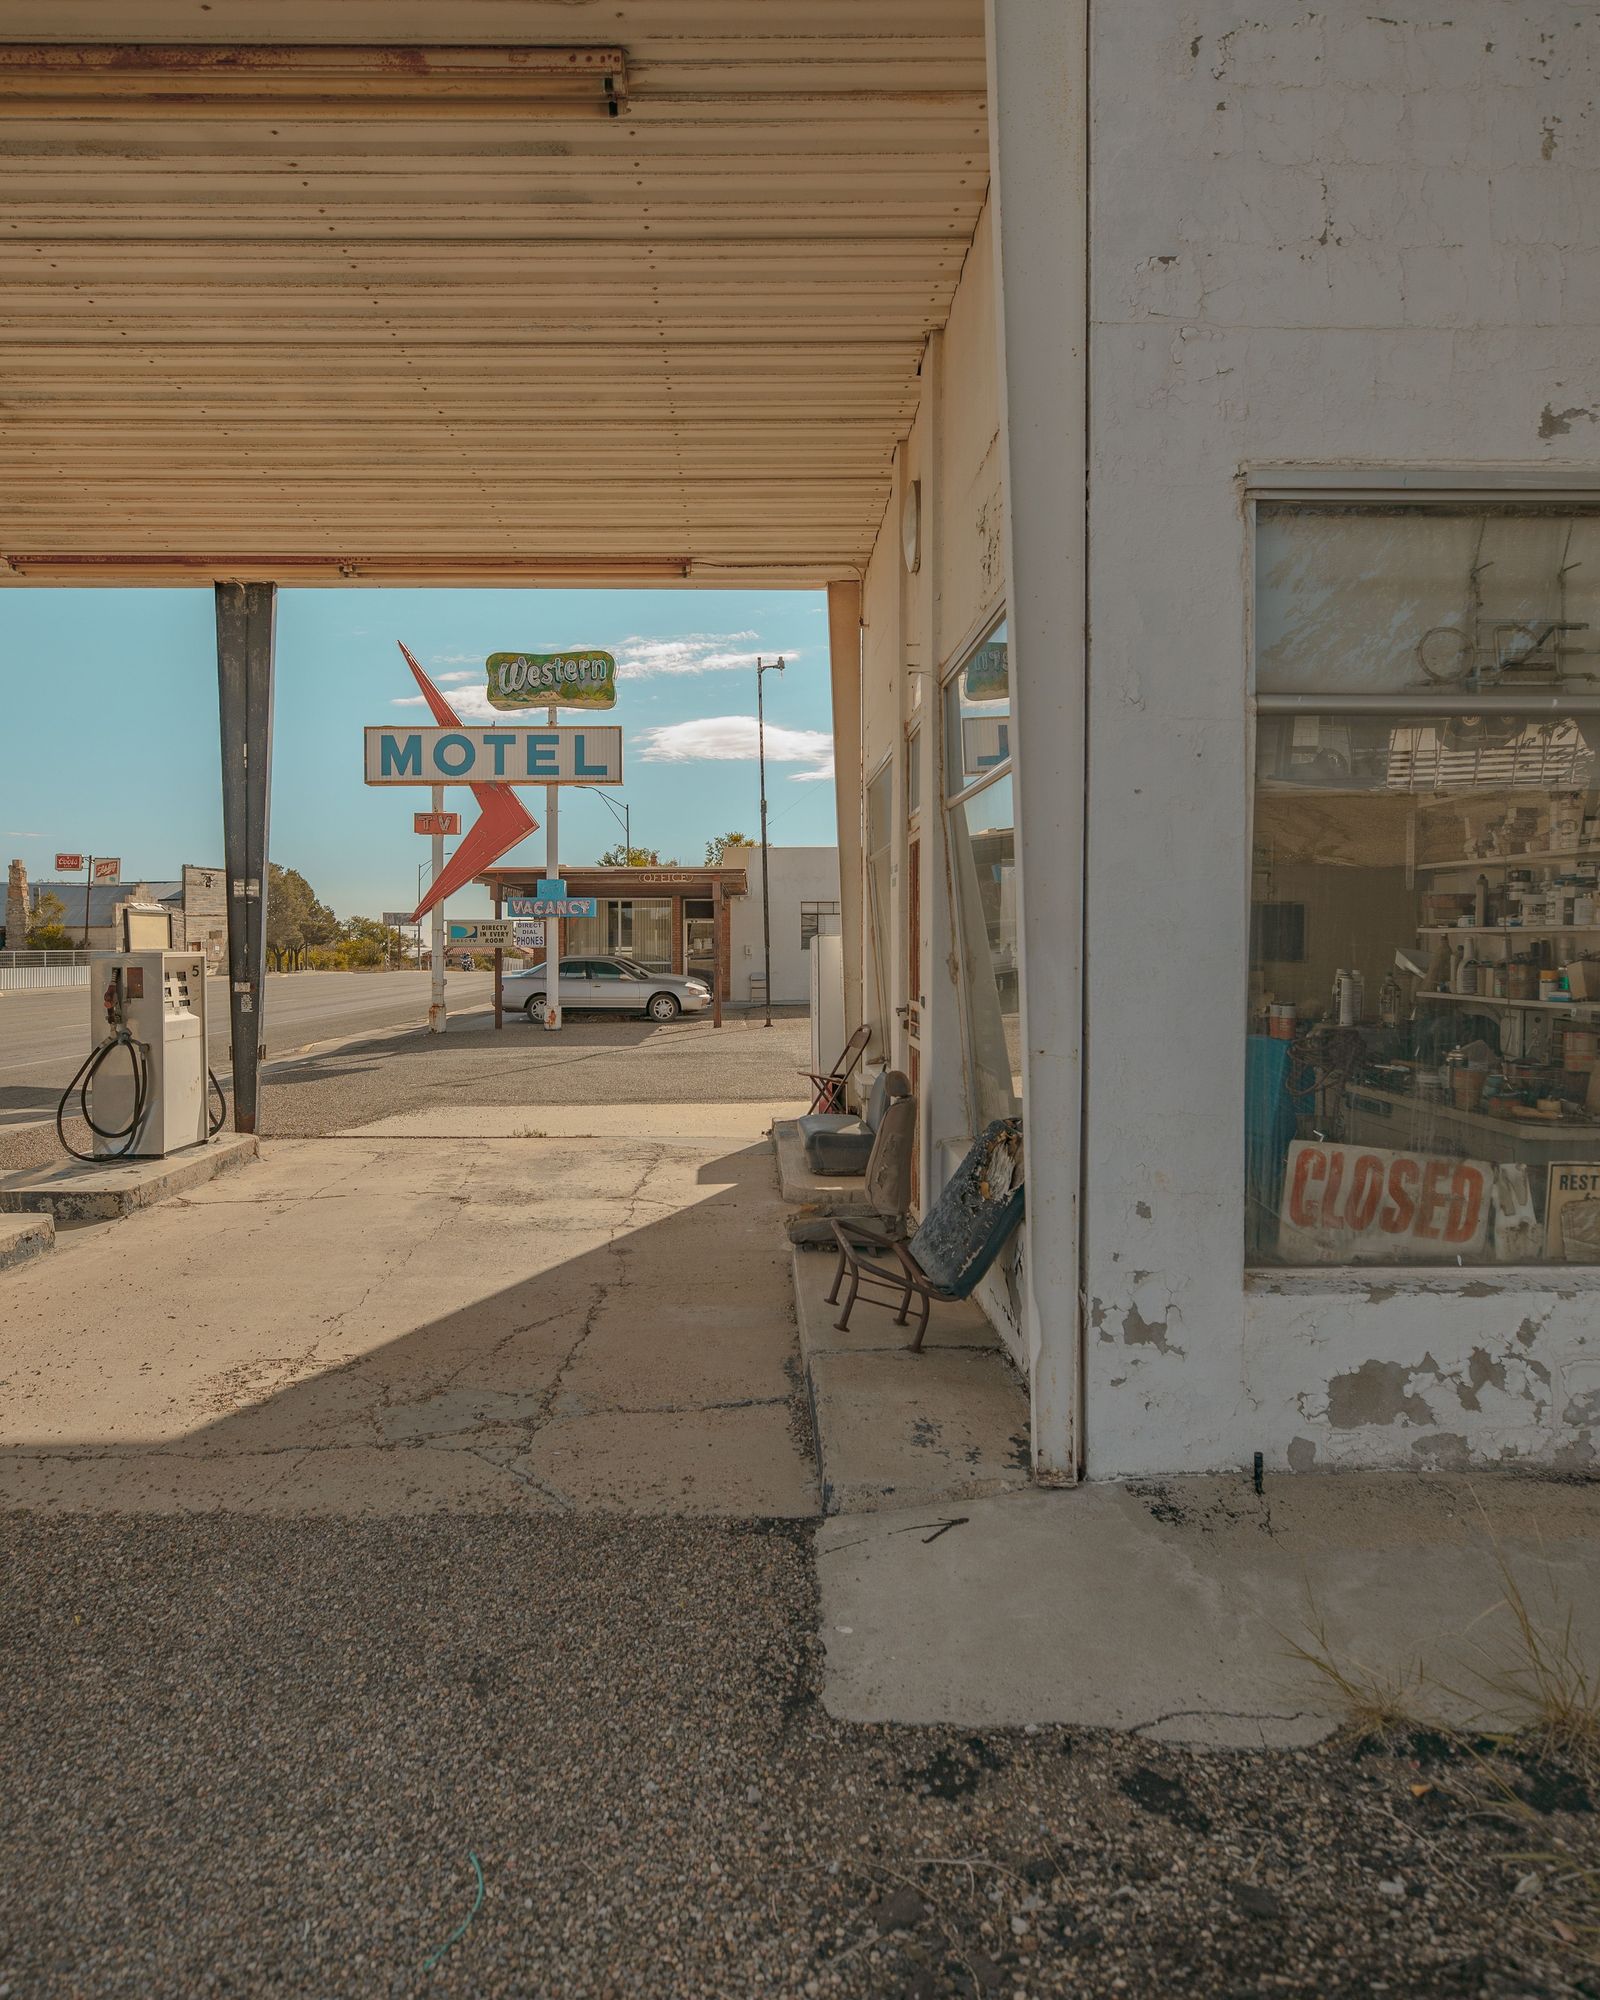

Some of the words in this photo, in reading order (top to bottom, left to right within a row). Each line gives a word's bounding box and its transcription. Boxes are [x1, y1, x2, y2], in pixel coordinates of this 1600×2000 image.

[498, 657, 607, 695] Western
[380, 733, 608, 776] MOTEL
[416, 815, 453, 832] TV
[511, 900, 591, 915] VACANCY
[516, 936, 544, 946] PHONES
[192, 965, 200, 977] 5
[1559, 1174, 1600, 1190] REST
[1289, 1147, 1484, 1243] CLOSED
